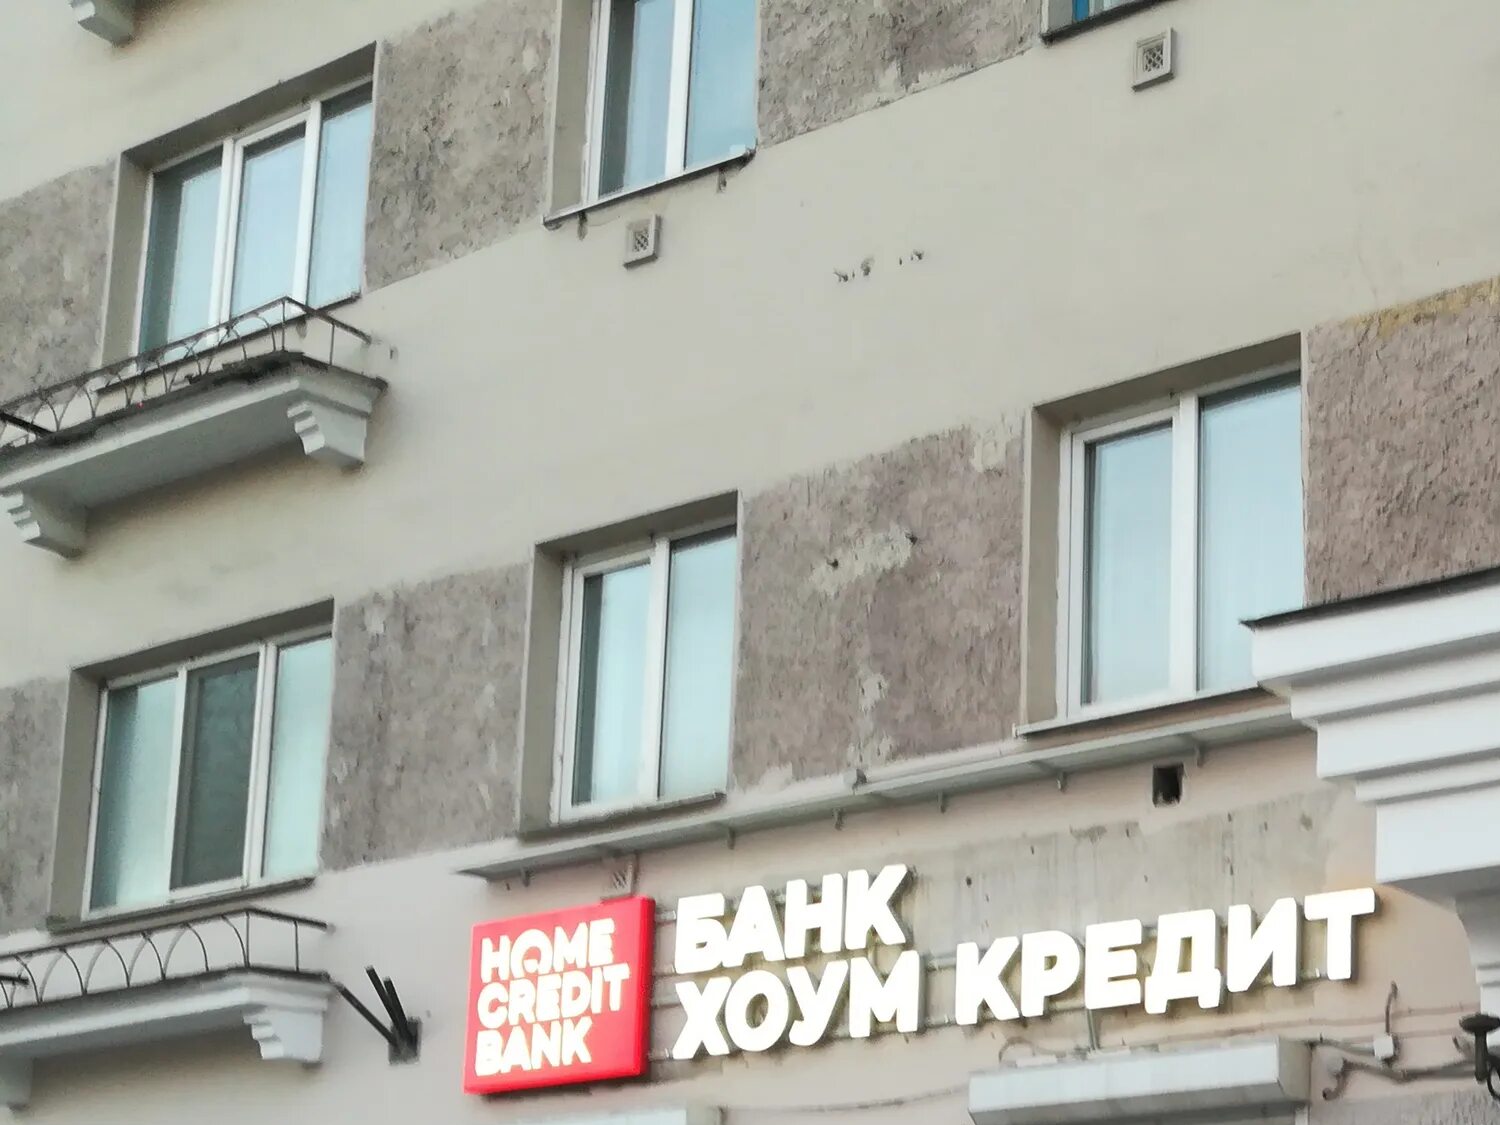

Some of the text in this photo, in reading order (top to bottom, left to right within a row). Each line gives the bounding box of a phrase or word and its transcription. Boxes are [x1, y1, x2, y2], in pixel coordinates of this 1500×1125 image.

[479, 918, 615, 983] HOME
[673, 863, 910, 974] БАНК
[477, 964, 631, 1029] CREDIT
[672, 887, 1377, 1060] ХОУМ КРЕДИТ
[474, 1016, 593, 1077] BANK
